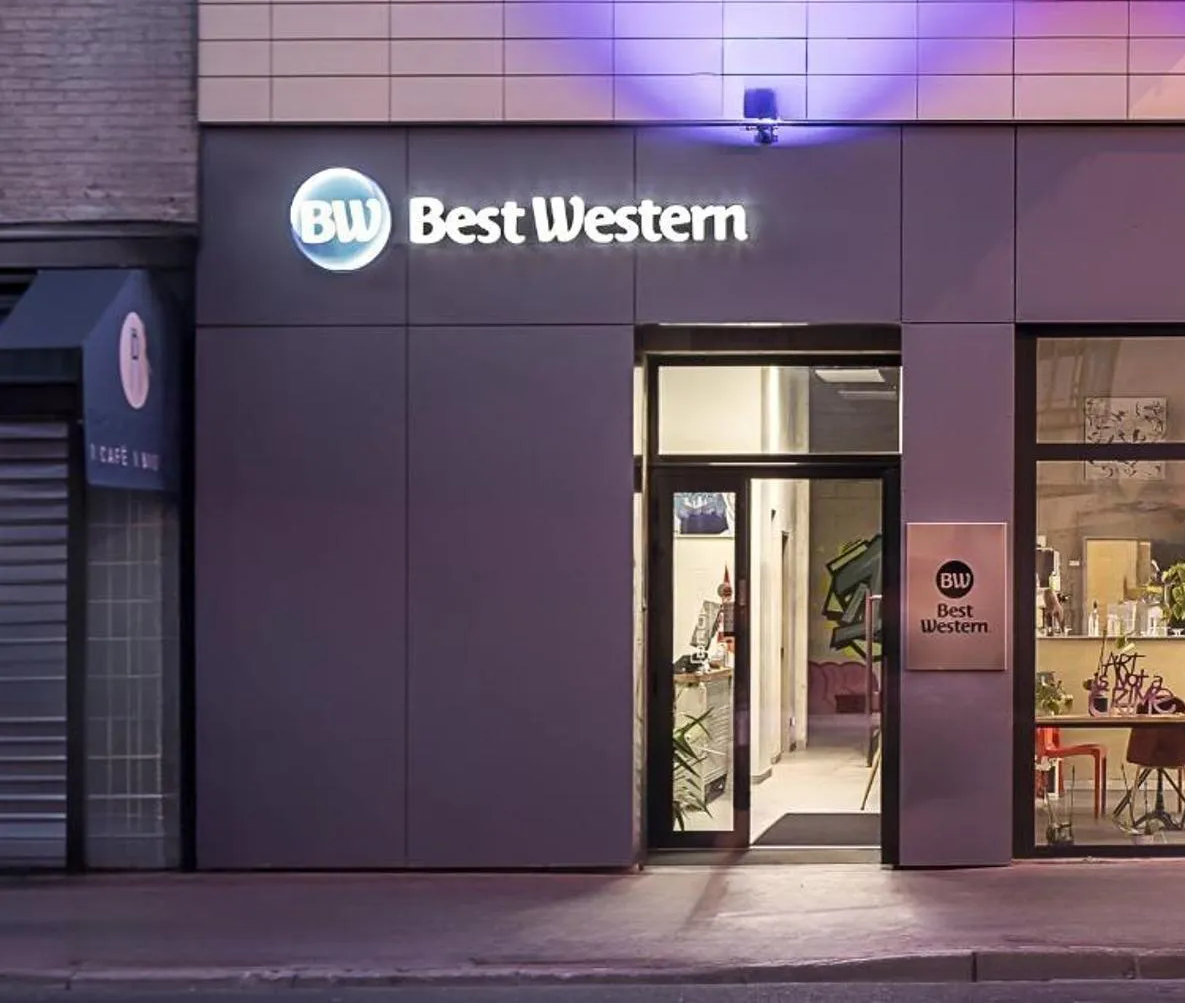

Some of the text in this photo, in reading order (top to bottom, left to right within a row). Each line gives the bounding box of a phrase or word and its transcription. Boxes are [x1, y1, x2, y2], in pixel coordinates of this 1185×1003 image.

[301, 197, 383, 244] BW
[409, 196, 749, 244] Best Western
[940, 572, 971, 589] BW
[937, 603, 973, 618] Best
[920, 619, 988, 633] Western
[1102, 652, 1146, 677] ART
